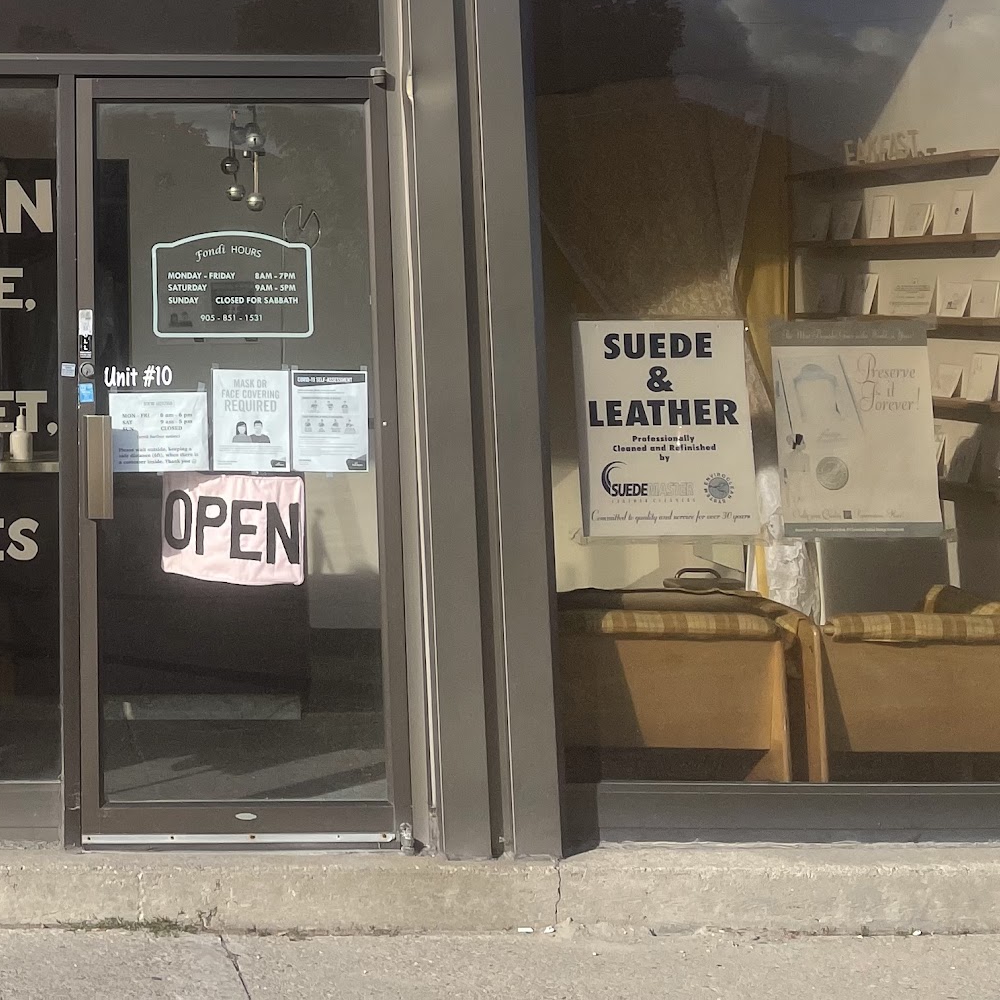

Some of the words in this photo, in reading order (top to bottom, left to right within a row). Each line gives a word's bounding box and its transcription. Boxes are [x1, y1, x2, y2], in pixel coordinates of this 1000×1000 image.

[196, 244, 225, 262] Fondi
[231, 246, 262, 258] HOURS
[603, 332, 713, 359] SUEDE
[104, 366, 138, 387] Unit
[142, 365, 172, 387] #10
[856, 353, 916, 382] Preserve
[233, 379, 254, 388] MASK
[257, 379, 267, 388] OR
[646, 366, 674, 392] &
[221, 390, 240, 399] FACE
[243, 390, 279, 399] COVERING
[224, 400, 277, 412] REQUIRED
[589, 399, 739, 427] LEATHER
[632, 435, 695, 443] Professionally
[660, 454, 670, 462] by
[591, 509, 627, 522] Committed
[635, 510, 657, 523] quality
[659, 509, 672, 520] and
[722, 512, 731, 520] 30
[164, 489, 300, 565] OPEN
